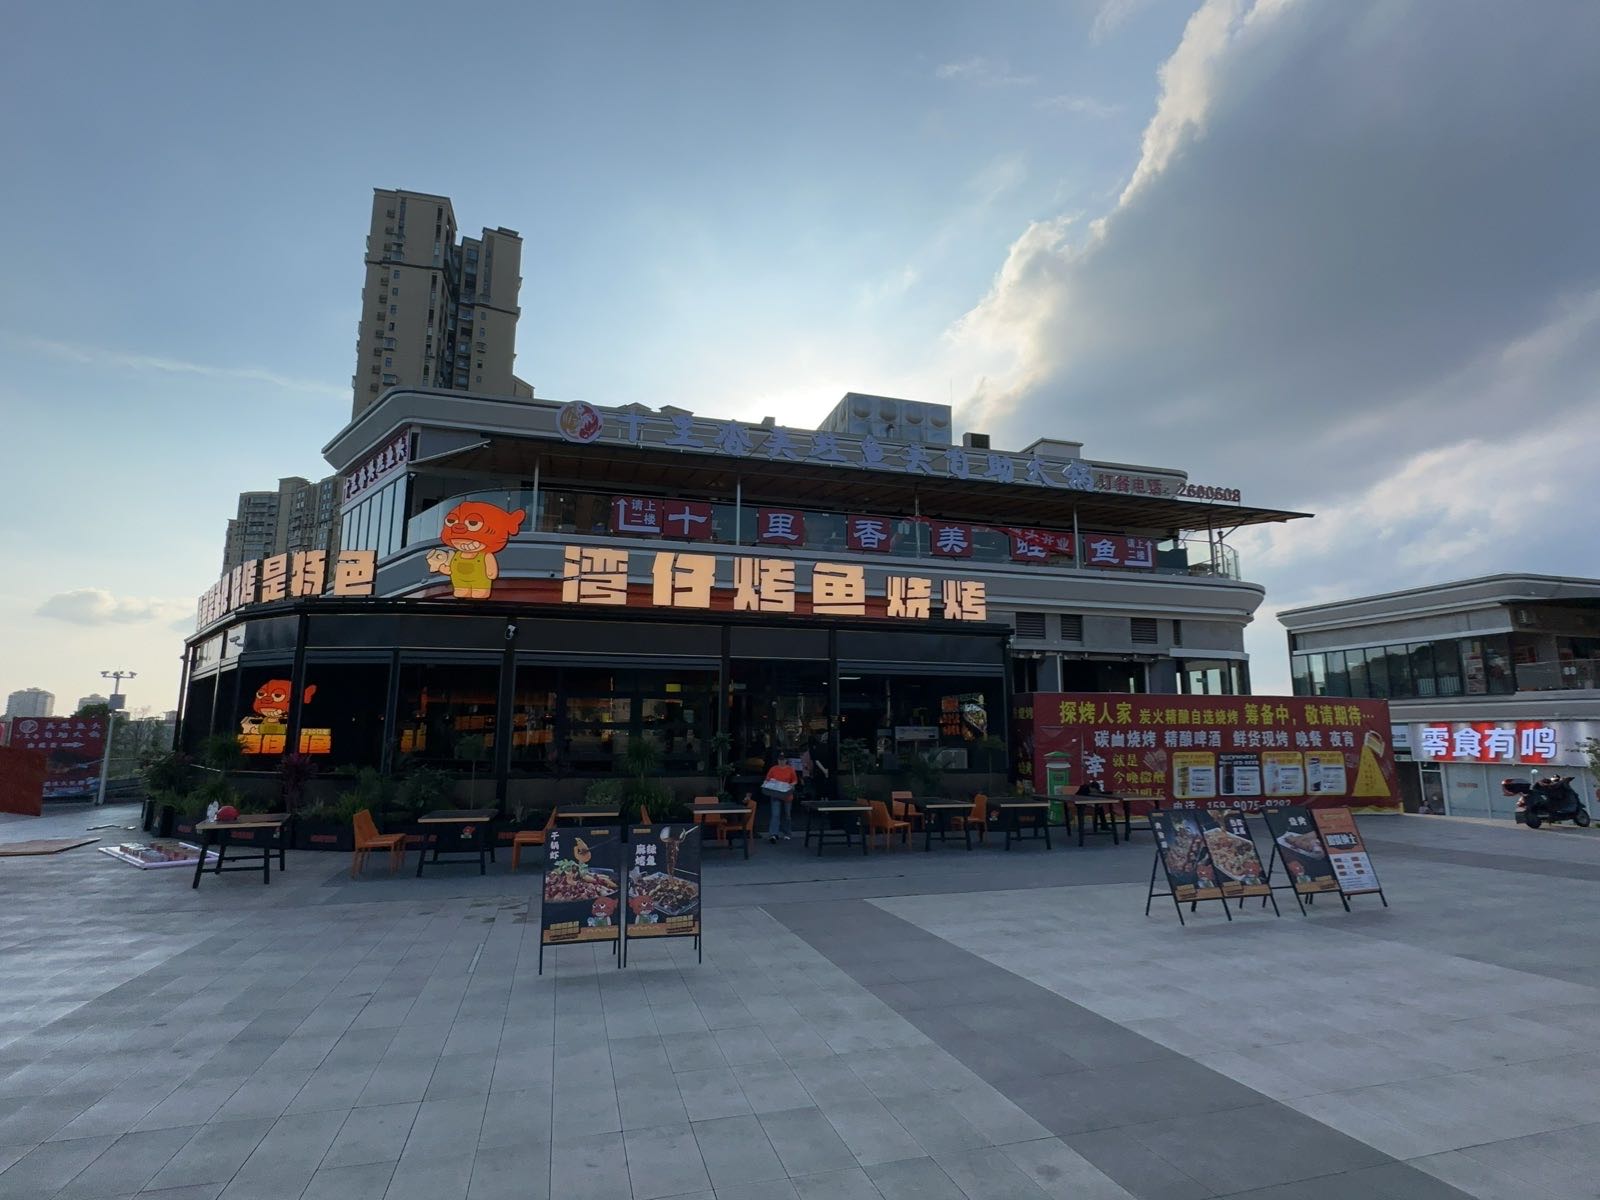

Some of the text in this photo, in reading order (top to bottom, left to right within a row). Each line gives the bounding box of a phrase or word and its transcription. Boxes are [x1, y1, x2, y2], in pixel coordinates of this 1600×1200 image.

[562, 545, 986, 621] 湾仔烤鱼烧烤
[1060, 700, 1133, 725] 探烤人家
[1164, 730, 1222, 748] 精酿啤酒
[1233, 730, 1289, 748] 鲜货现烤
[1295, 730, 1322, 747] 晚餐
[1329, 730, 1355, 747] 夜宵
[1421, 726, 1557, 759] 零食有鸣
[1112, 753, 1139, 768] 就是
